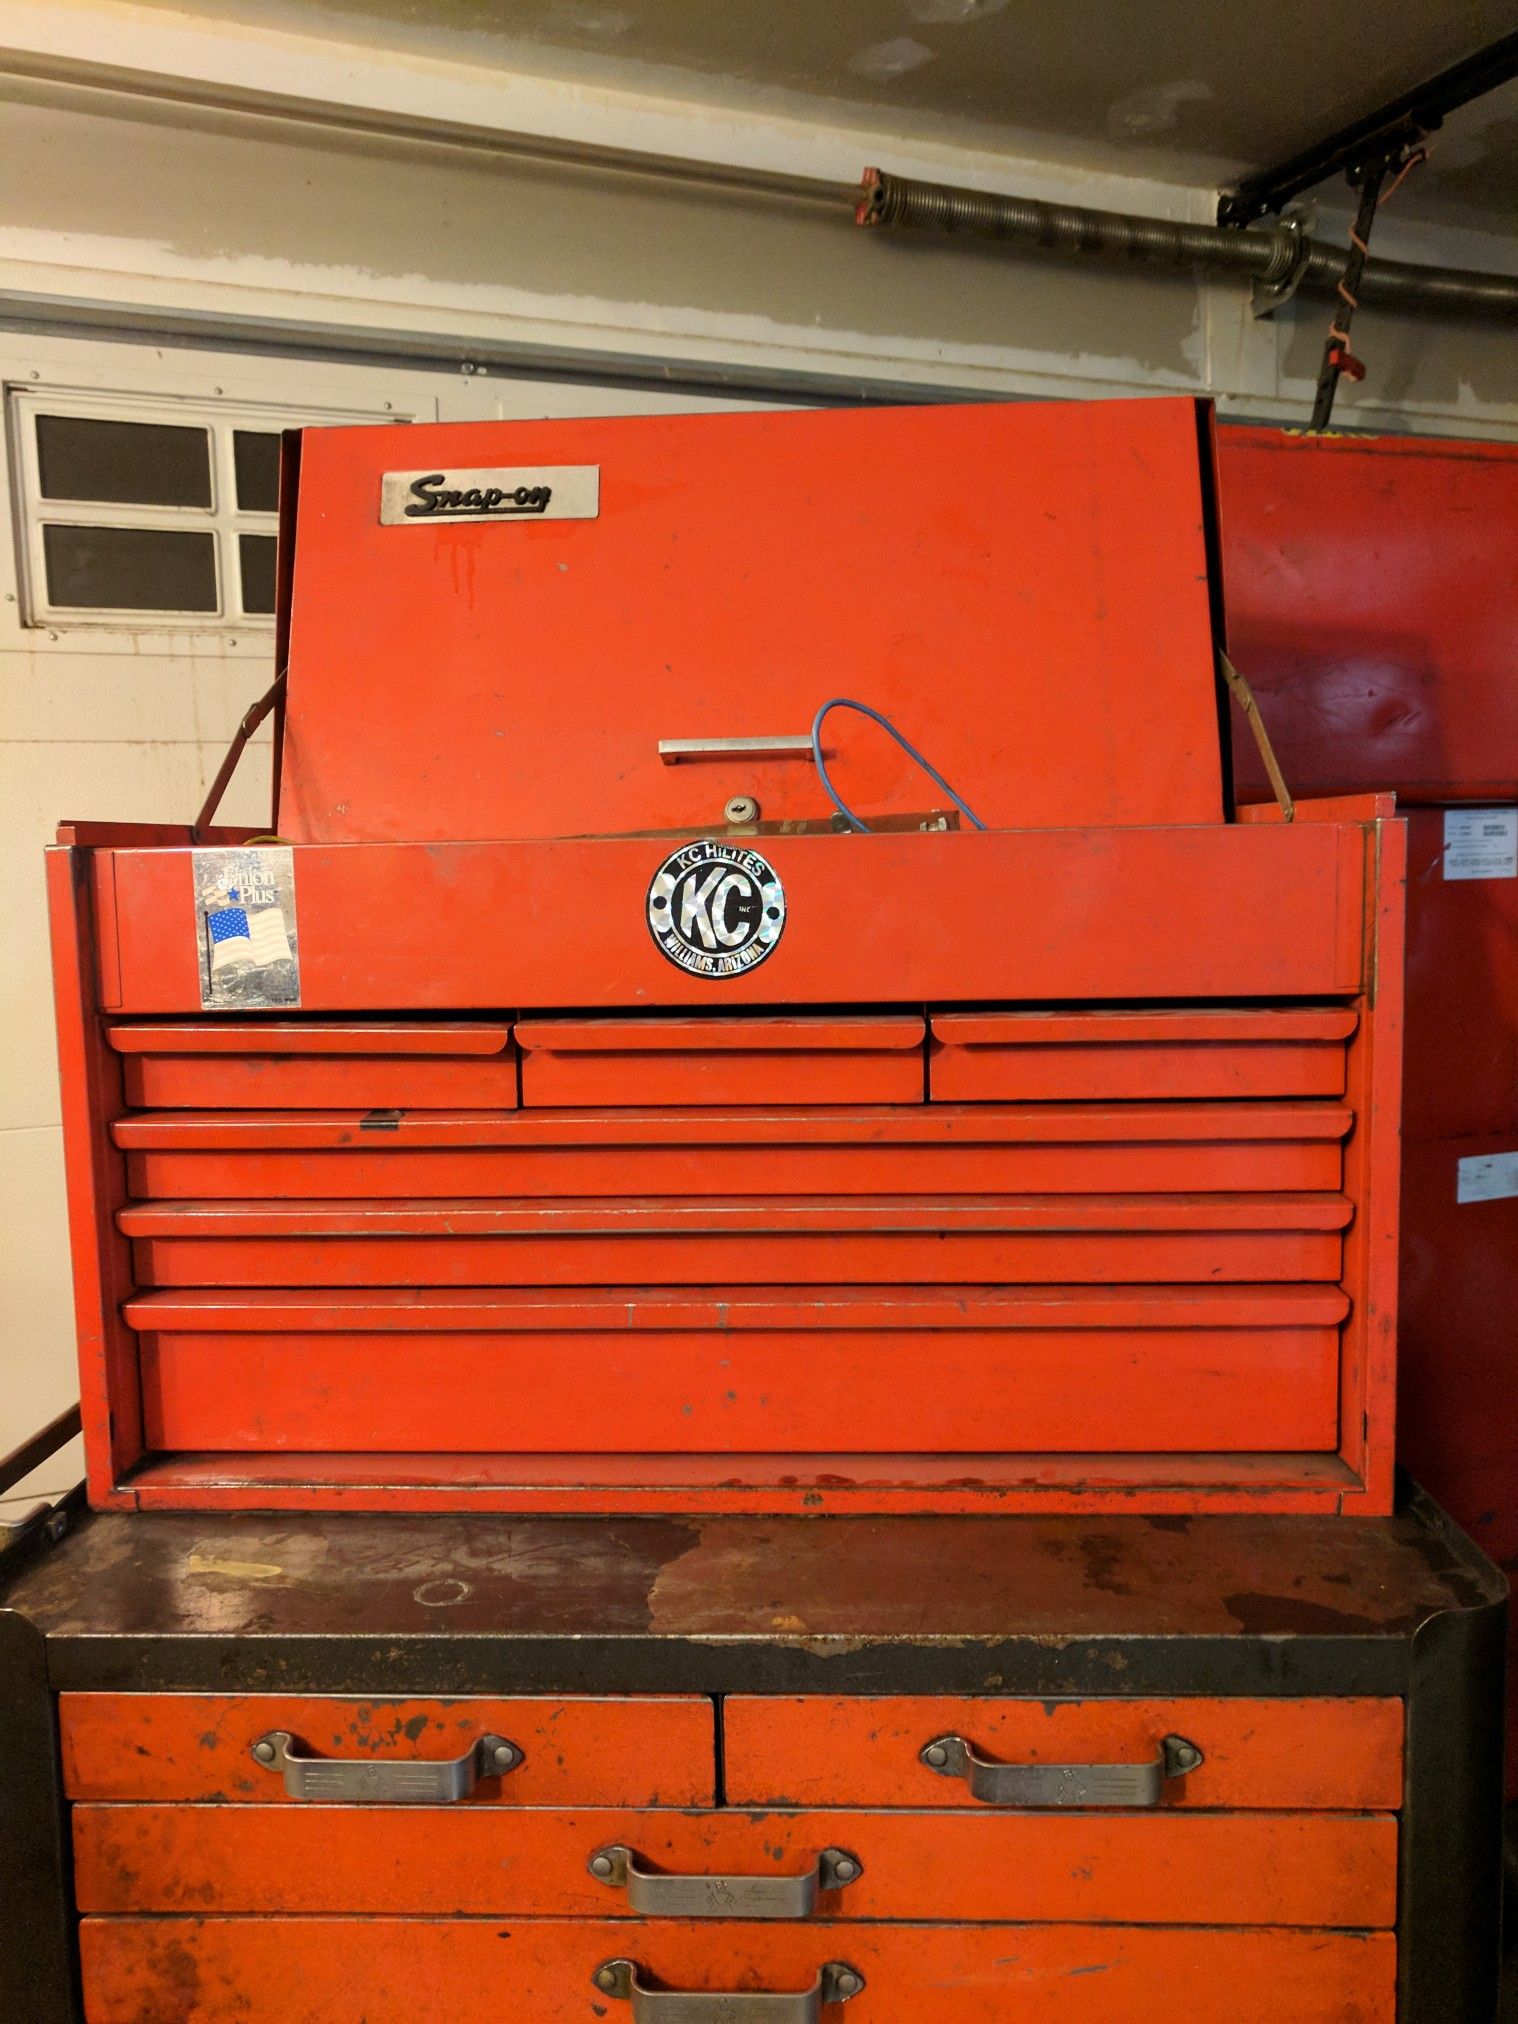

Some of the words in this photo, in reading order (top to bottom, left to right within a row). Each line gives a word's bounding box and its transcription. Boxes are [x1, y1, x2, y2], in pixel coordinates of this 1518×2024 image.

[404, 474, 552, 517] Snap-on
[676, 847, 702, 869] KC
[239, 885, 275, 904] Plus
[680, 866, 752, 949] KC
[718, 943, 764, 972] ARIZONA
